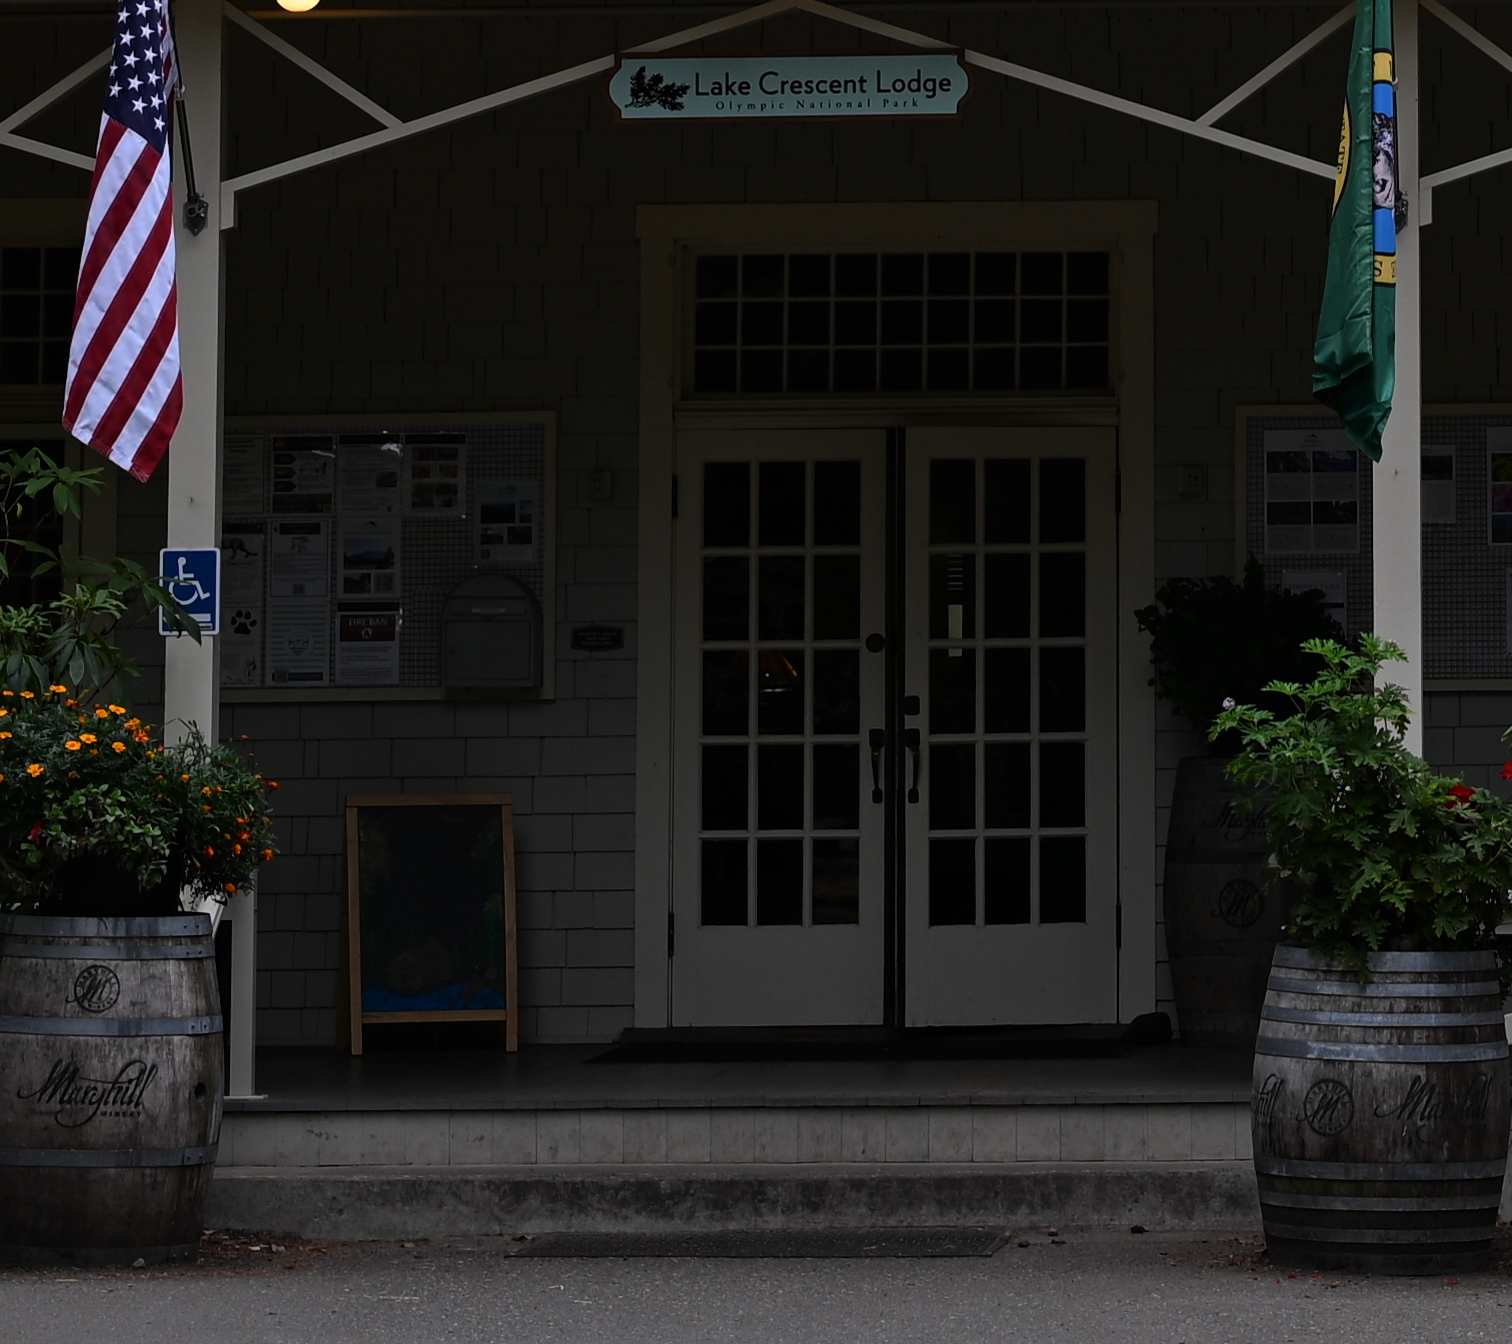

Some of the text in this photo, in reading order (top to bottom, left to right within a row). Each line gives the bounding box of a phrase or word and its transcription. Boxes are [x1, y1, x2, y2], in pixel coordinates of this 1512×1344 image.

[694, 69, 952, 98] Lake Crescent Lodge
[715, 97, 919, 112] Olympic National Park
[17, 1058, 158, 1128] Maryhill
[100, 1110, 142, 1118] WINERY
